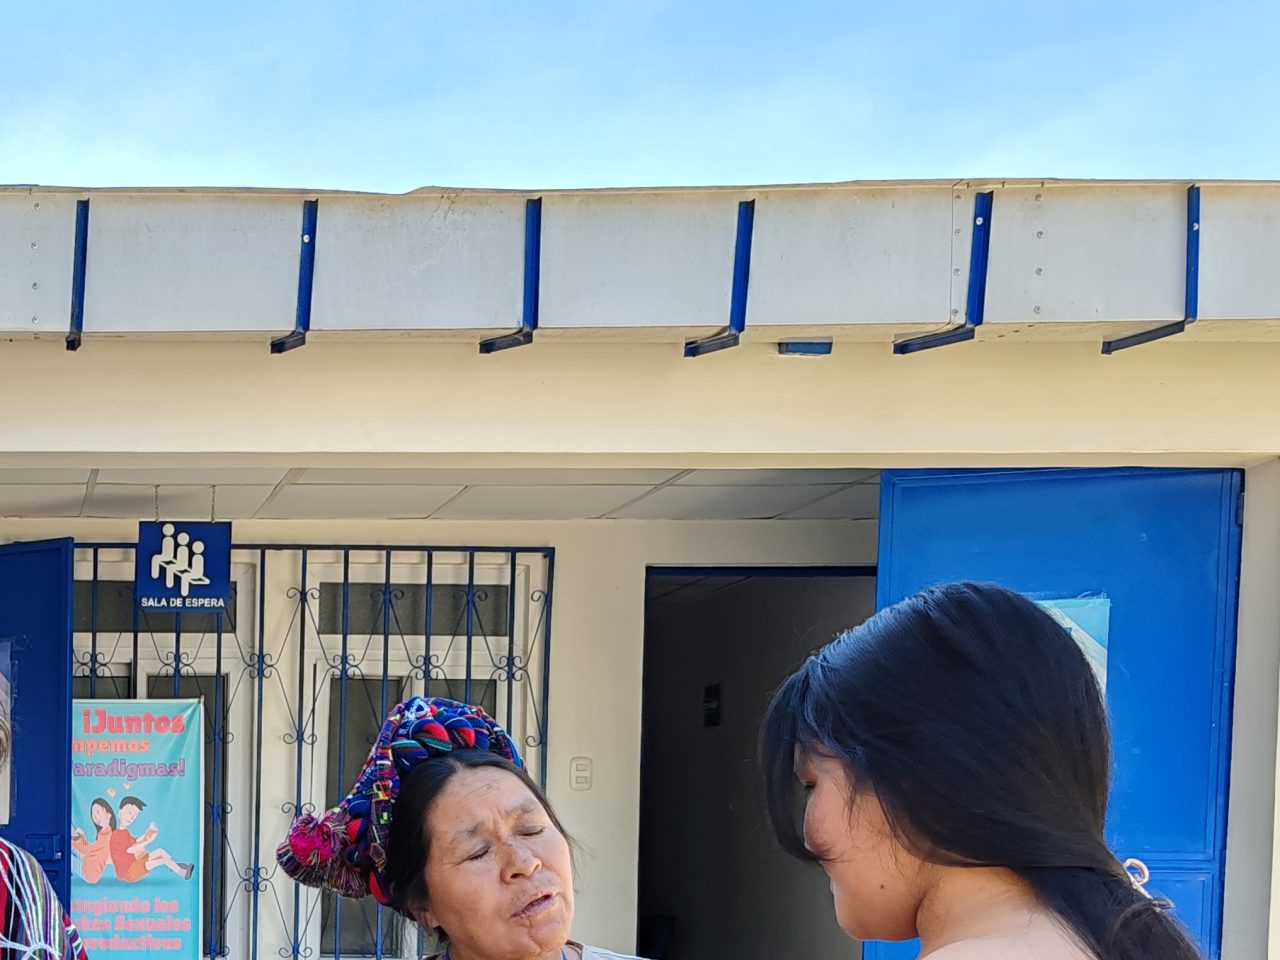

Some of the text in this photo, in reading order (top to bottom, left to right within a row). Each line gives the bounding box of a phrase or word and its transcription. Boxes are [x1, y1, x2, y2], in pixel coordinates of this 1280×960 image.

[141, 597, 225, 608] SALA DE ESPERA
[71, 758, 185, 781] aradigmas!
